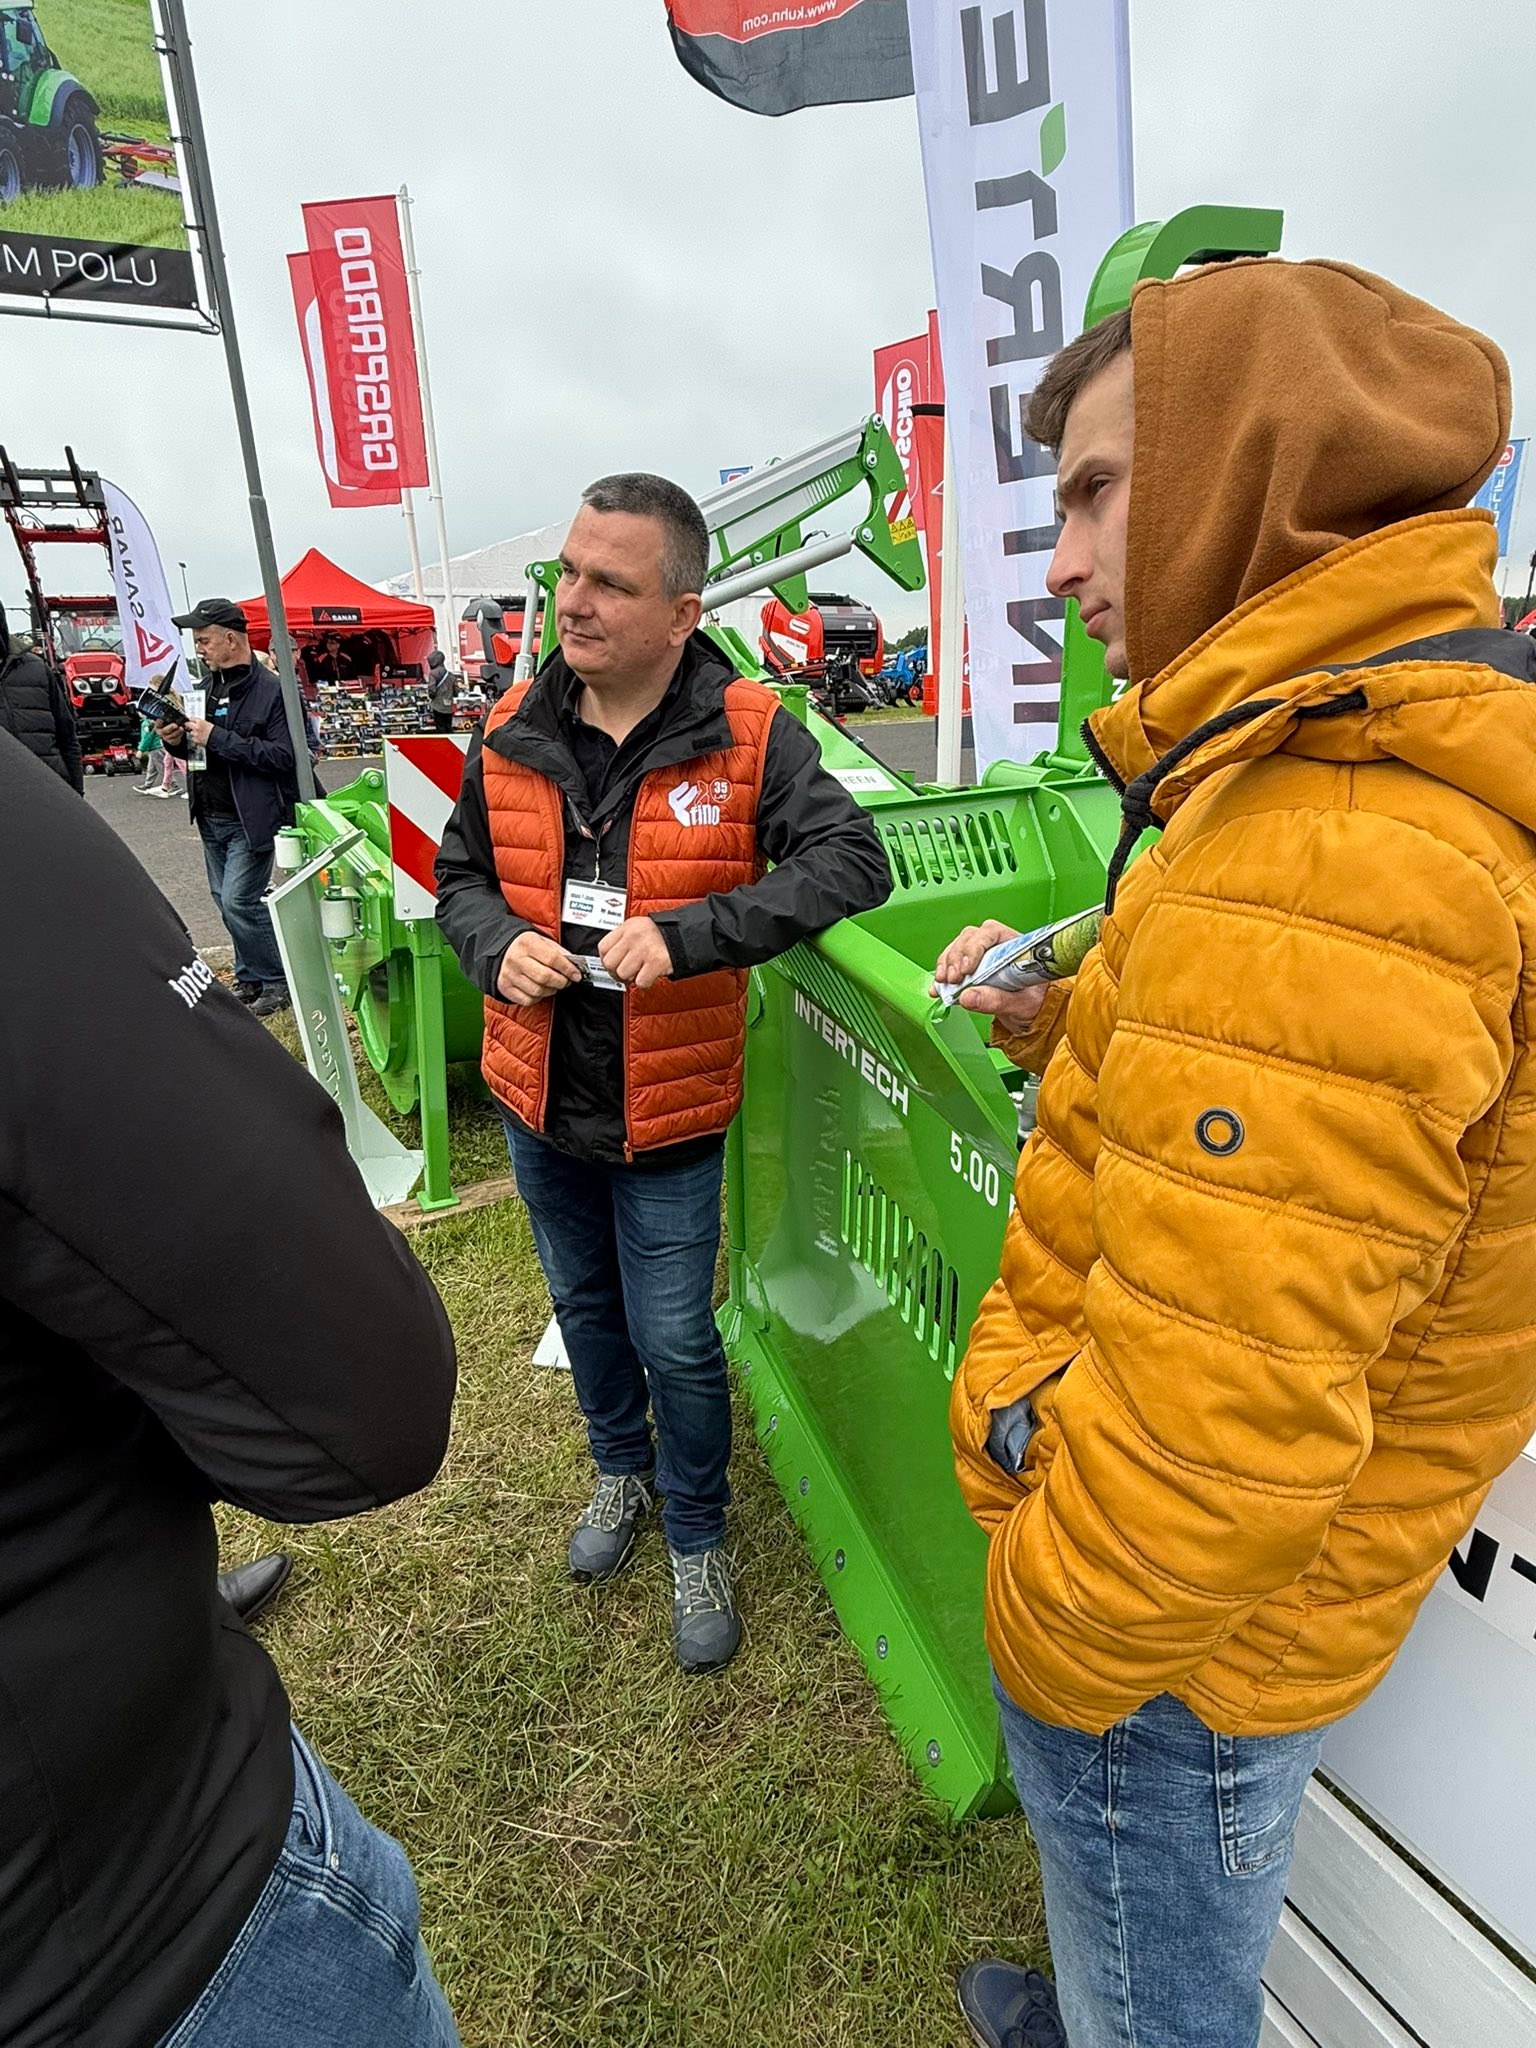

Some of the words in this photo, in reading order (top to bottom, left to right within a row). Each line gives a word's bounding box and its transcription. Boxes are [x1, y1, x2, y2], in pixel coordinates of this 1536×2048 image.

[0, 243, 41, 277] M
[51, 249, 158, 287] POLU
[331, 613, 358, 621] SANAR
[713, 780, 728, 794] 35
[793, 988, 909, 1116] INTERTECH
[949, 1130, 1000, 1208] 5.00
